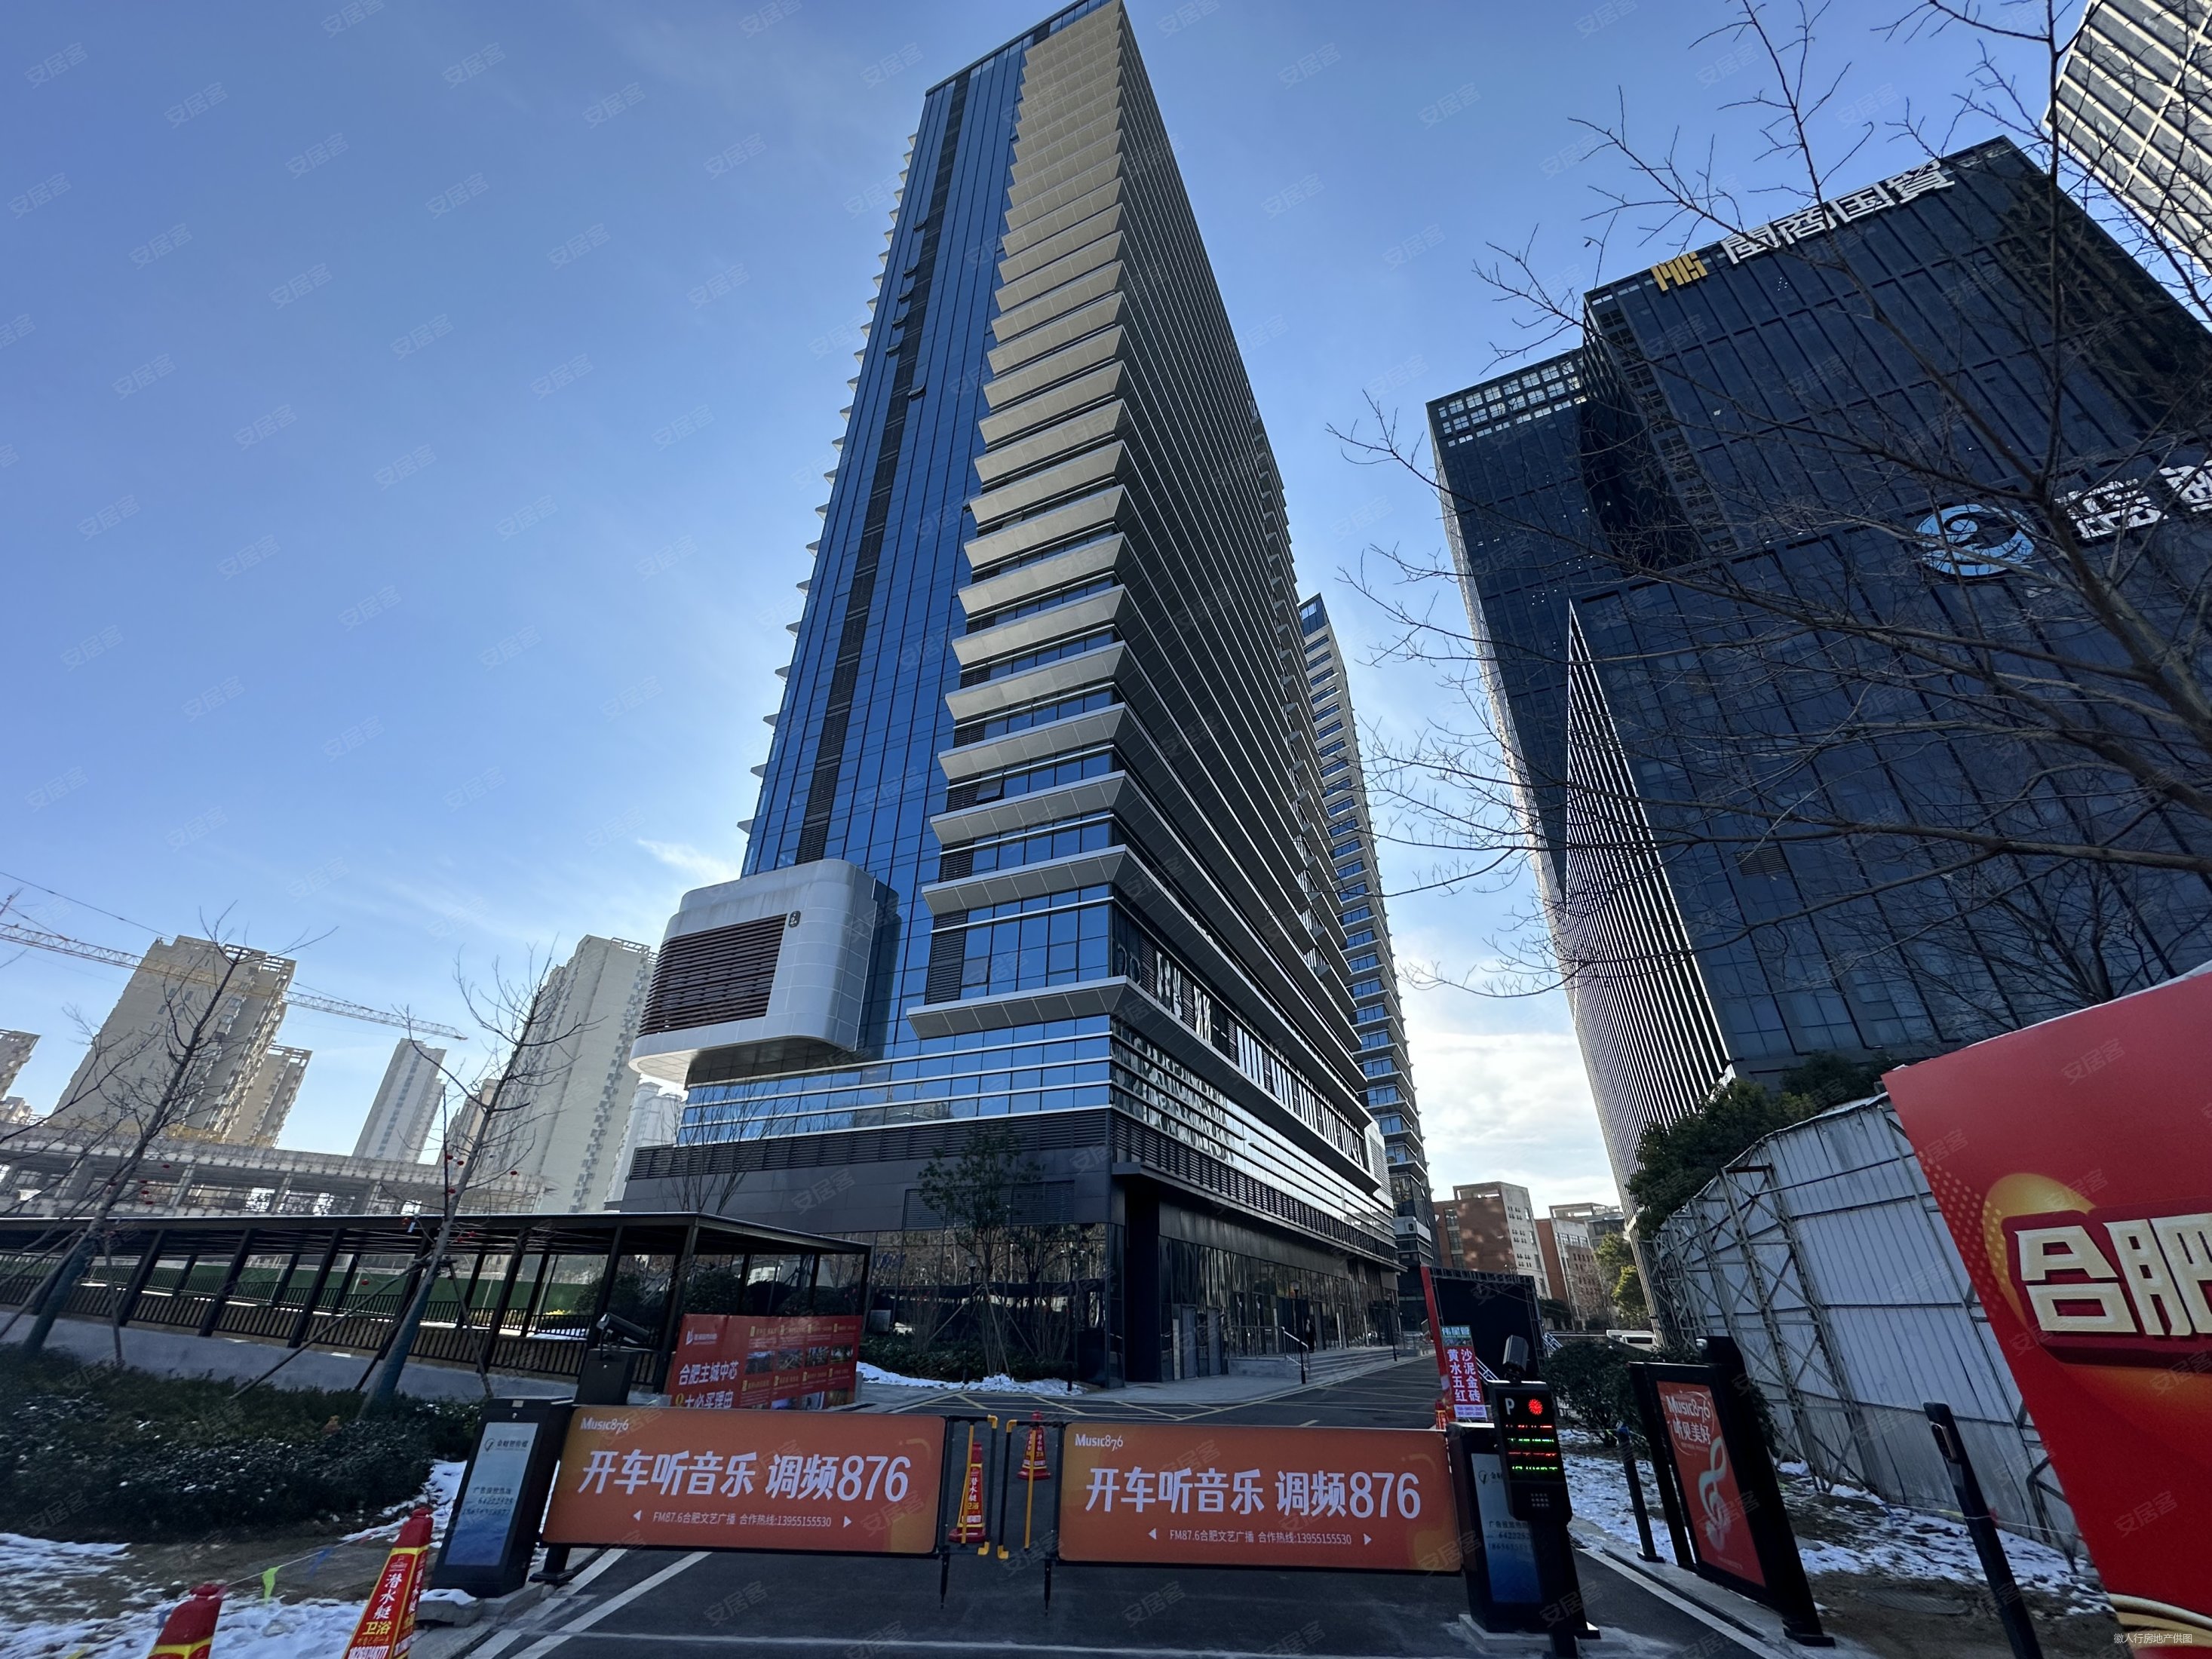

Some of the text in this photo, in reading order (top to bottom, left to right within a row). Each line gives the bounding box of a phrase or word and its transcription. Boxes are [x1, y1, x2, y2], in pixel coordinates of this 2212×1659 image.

[2014, 1213, 2212, 1336] 合肥
[1505, 1397, 1515, 1415] P
[1673, 1417, 1711, 1445] 听见美好
[578, 1449, 911, 1502] 开车听音乐 调频876
[1085, 1466, 1421, 1519] 开车听音乐 调频876
[652, 1511, 832, 1527] FM87.6合肥文艺广播 合作热线:13955155530
[1170, 1529, 1351, 1545] FM87.6合肥文艺广播 合作热线:13955155530
[373, 1572, 402, 1620] 潜水艇
[362, 1621, 391, 1636] 卫浴
